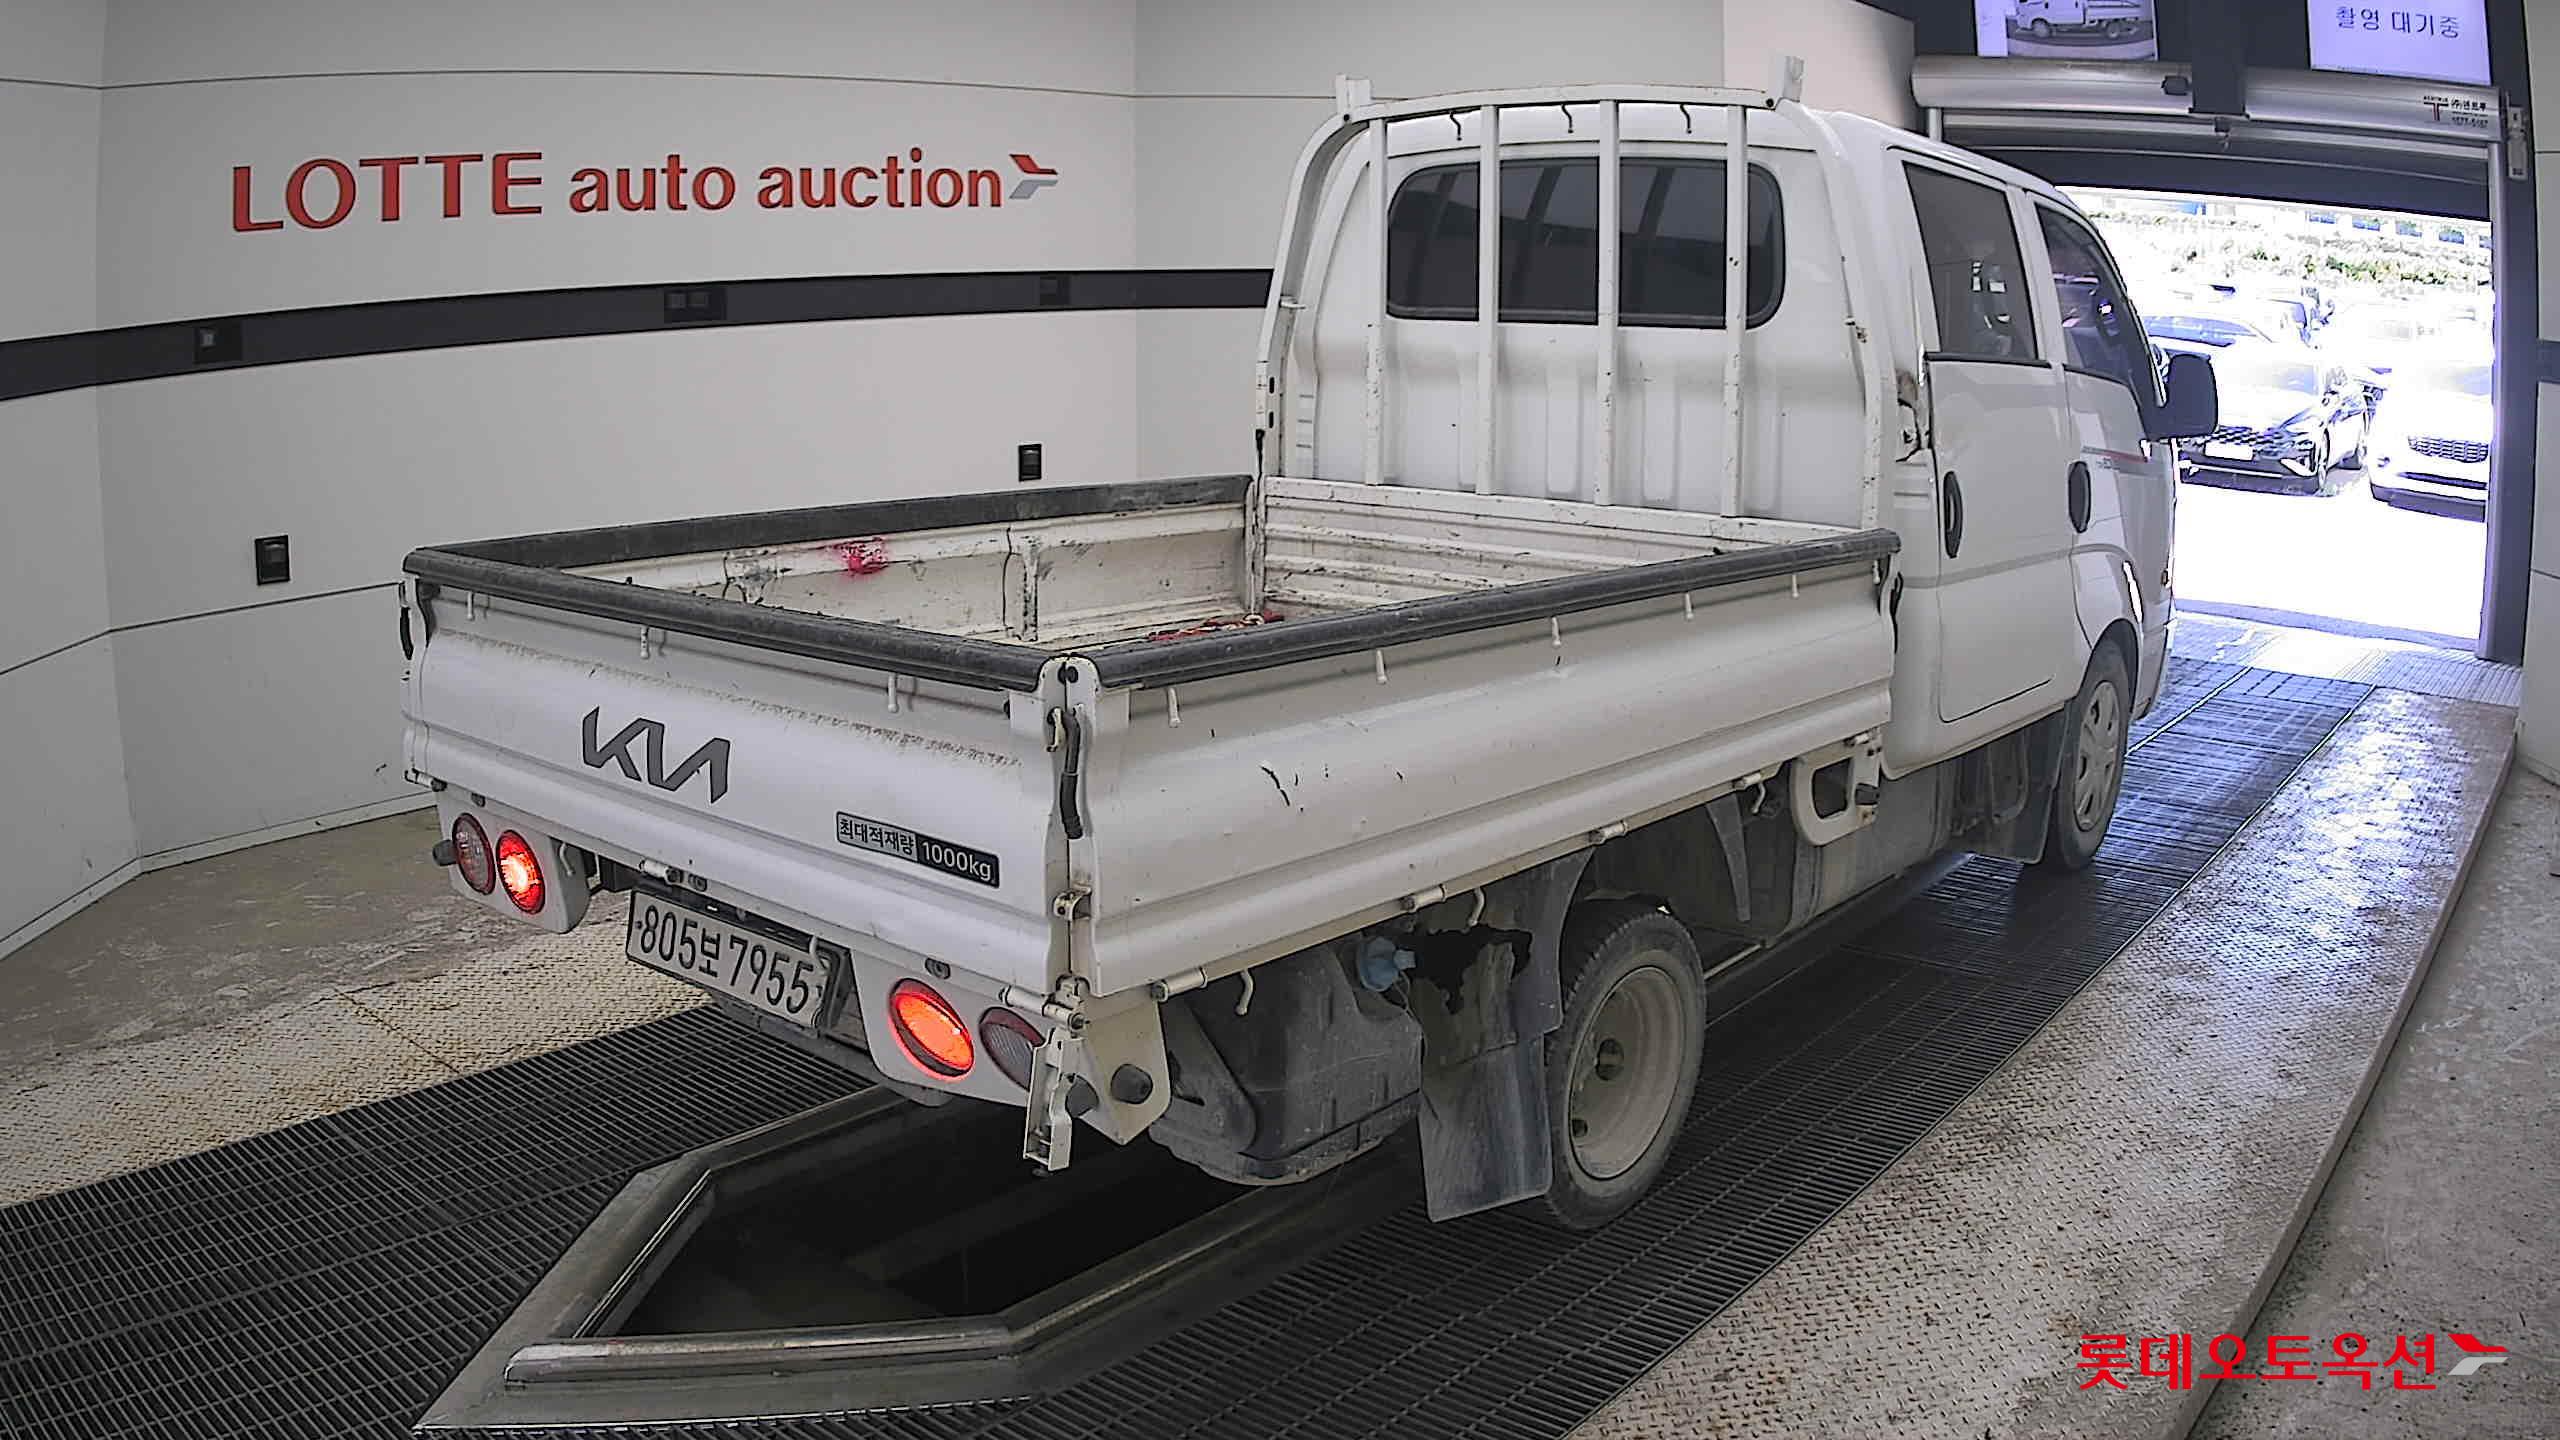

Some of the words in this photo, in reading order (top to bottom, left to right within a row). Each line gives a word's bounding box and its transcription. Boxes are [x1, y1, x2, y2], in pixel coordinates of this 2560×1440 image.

[233, 153, 544, 232] LOTTE
[571, 155, 737, 213] auto
[758, 147, 1003, 209] auction
[582, 705, 731, 804] KIA
[839, 818, 915, 856] 최대적재량
[921, 841, 992, 881] 1000kg
